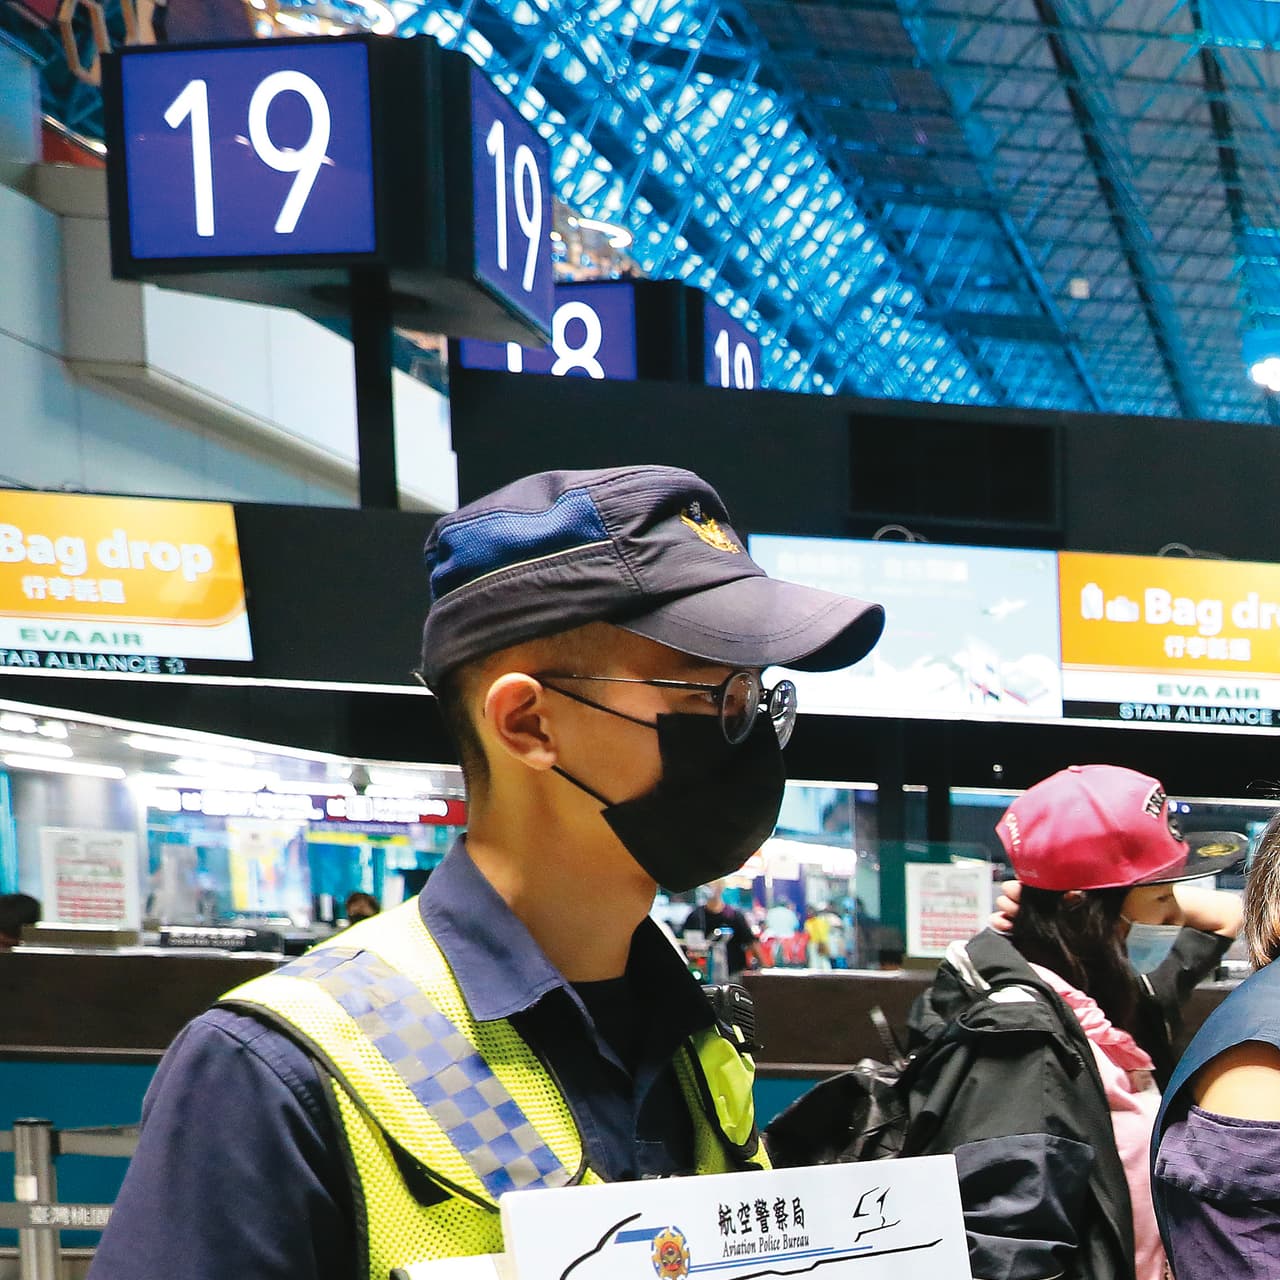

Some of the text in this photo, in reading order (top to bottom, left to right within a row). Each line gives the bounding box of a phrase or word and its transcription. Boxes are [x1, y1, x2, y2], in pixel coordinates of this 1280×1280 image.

[163, 70, 331, 236] 19
[486, 119, 543, 292] 19
[0, 522, 213, 582] Bag drop
[1144, 587, 1223, 636] Bag
[19, 628, 142, 646] EVA AIR
[0, 651, 161, 674] TAR ALLIANCE
[1157, 683, 1260, 700] EVA AIR
[1119, 703, 1273, 725] STAR ALLIANCE
[718, 1196, 805, 1237] 航空警察局
[722, 1233, 810, 1258] Aviation Police Bureau
